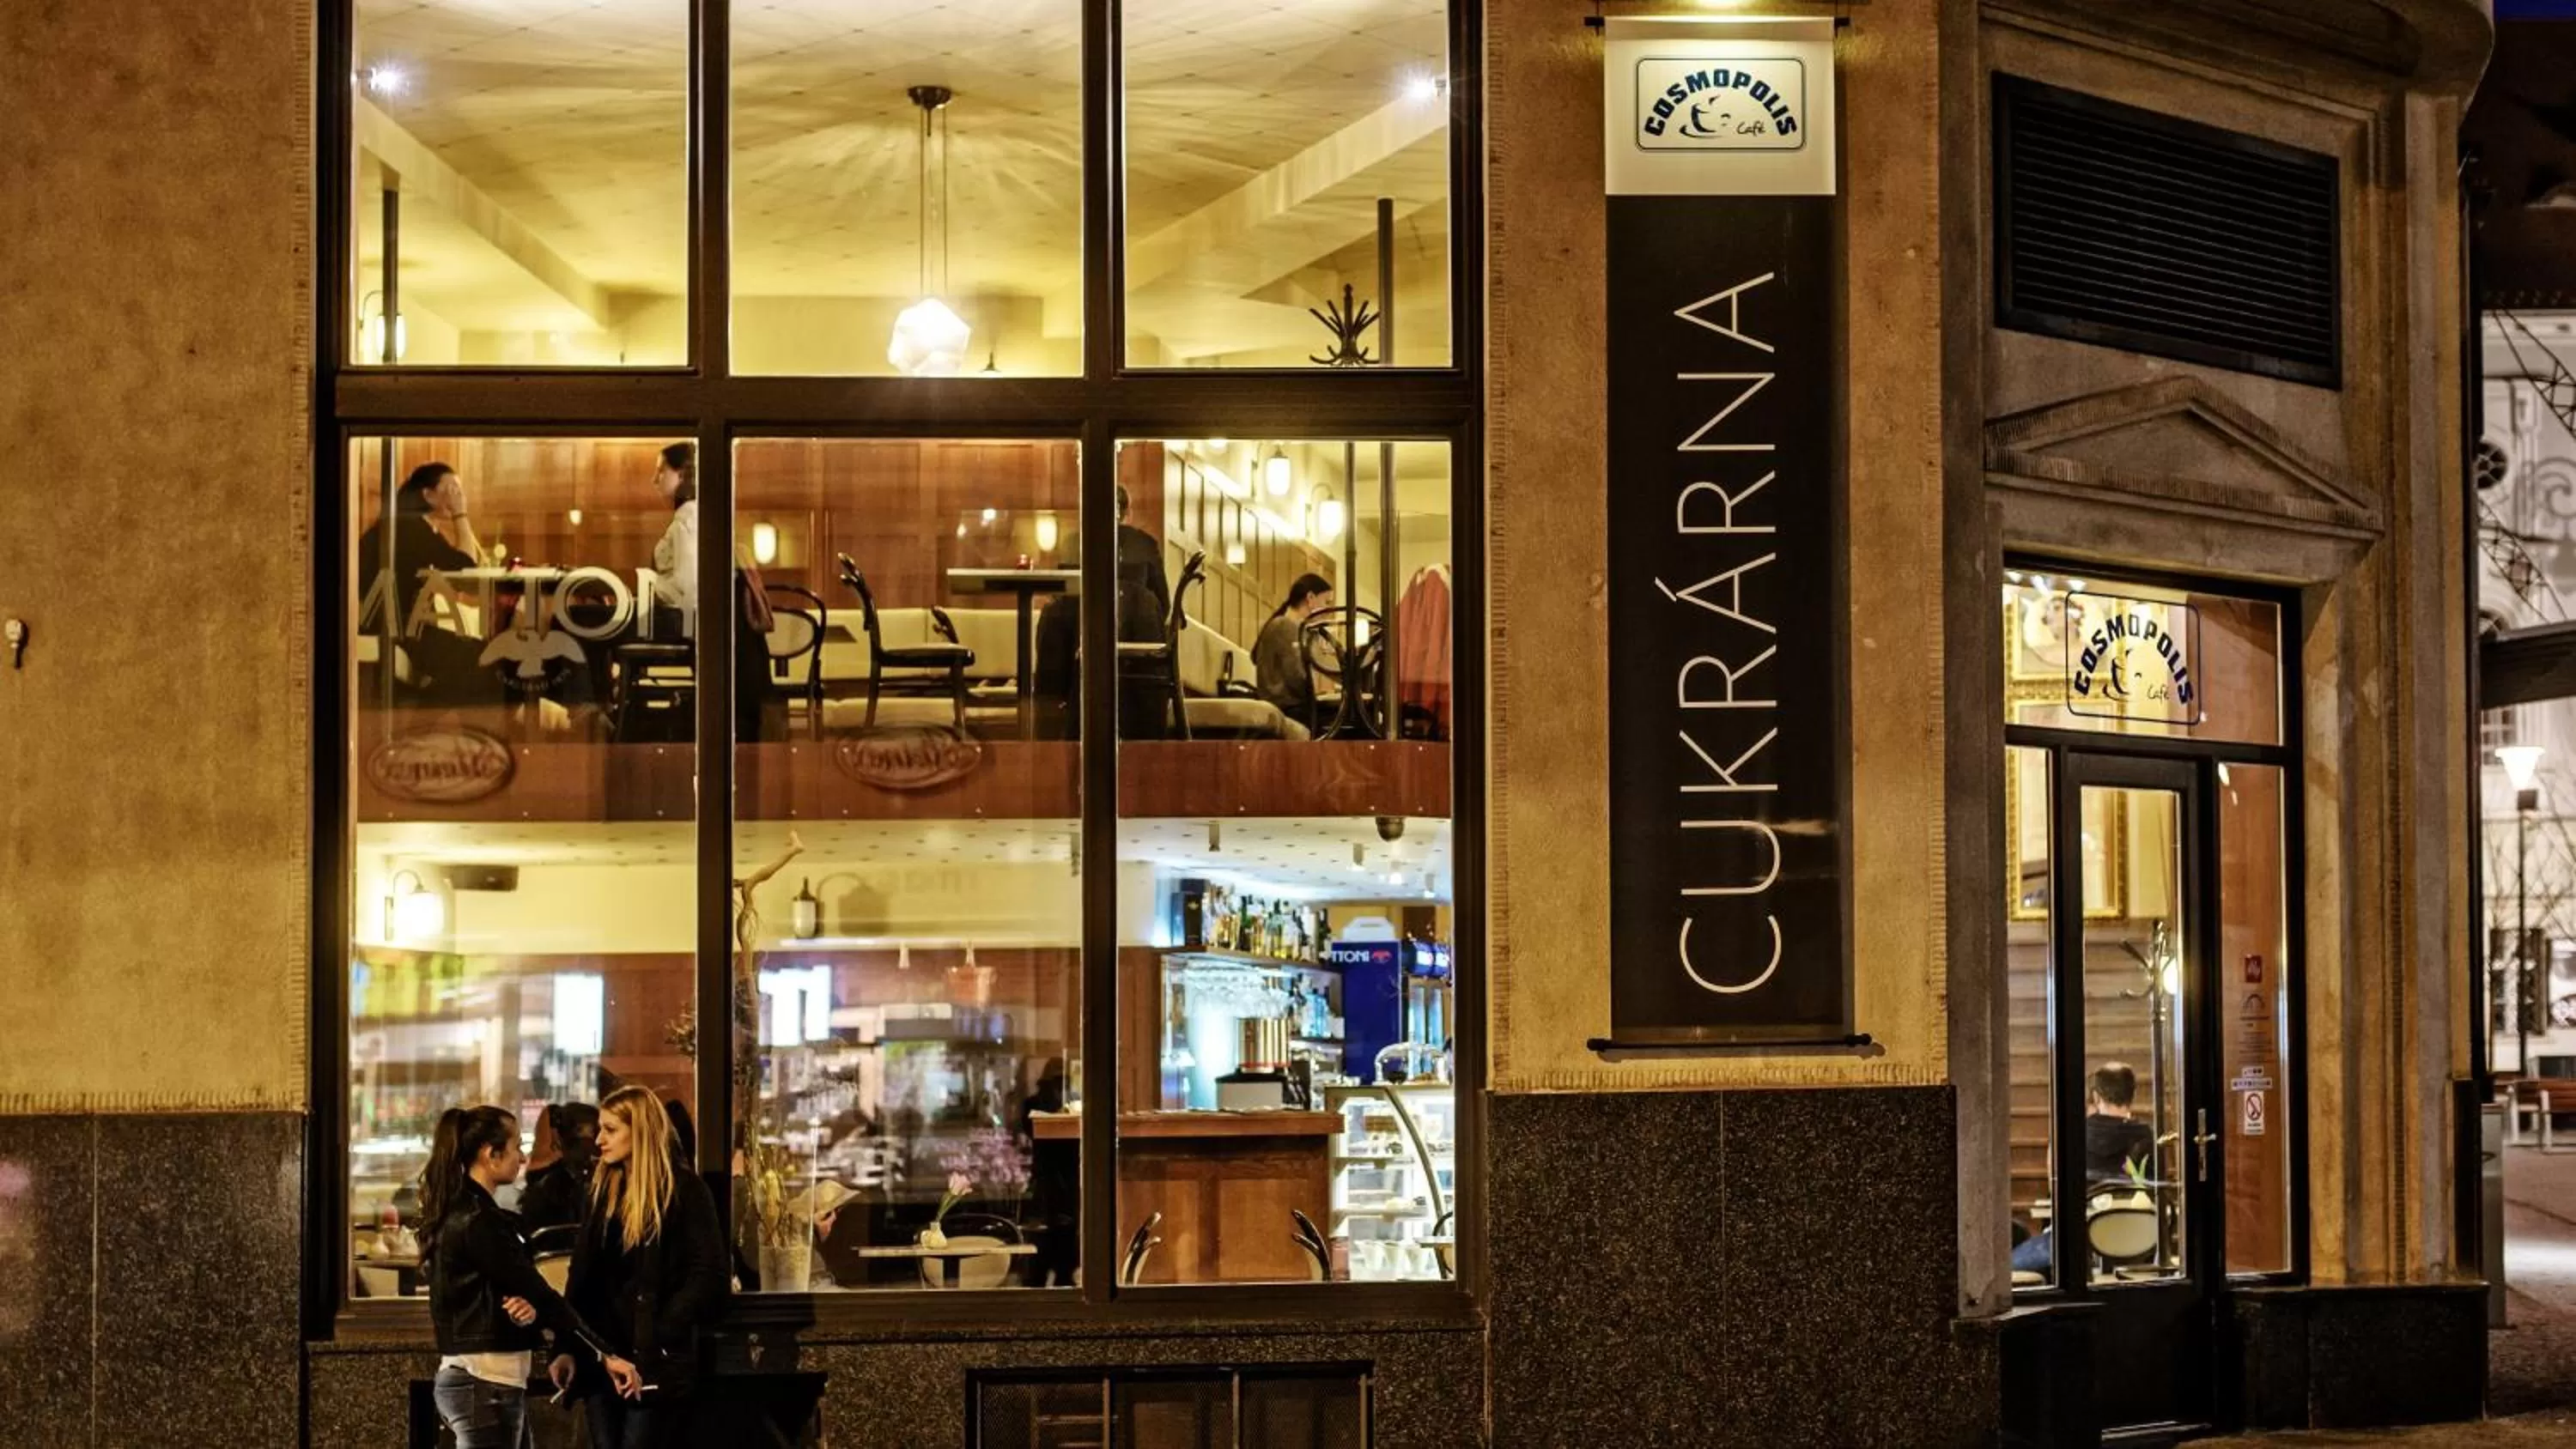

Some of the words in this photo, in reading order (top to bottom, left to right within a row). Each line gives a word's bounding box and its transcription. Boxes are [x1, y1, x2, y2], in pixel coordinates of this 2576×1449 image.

[1643, 69, 1797, 136] COSMOPOLIS
[1736, 120, 1766, 136] Café
[1656, 271, 1782, 993] CUKRÁRNA
[2075, 615, 2194, 703] COSMOPOLIS
